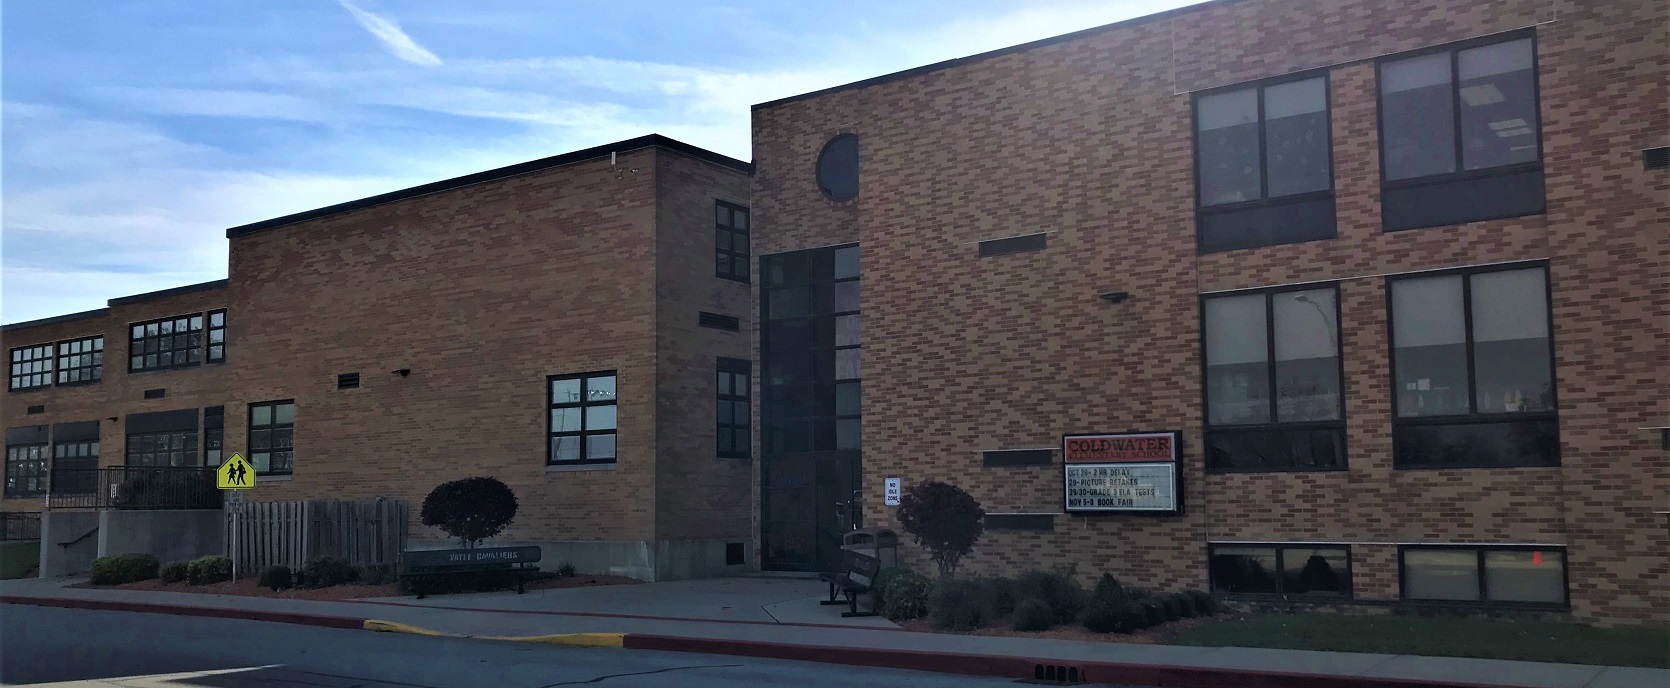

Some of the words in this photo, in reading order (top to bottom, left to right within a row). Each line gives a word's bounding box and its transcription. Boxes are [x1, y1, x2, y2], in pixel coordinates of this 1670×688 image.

[1068, 438, 1170, 452] COLDWATER
[1069, 451, 1126, 460] ELEMENTARY
[1132, 450, 1169, 458] SCHOOL
[1110, 468, 1130, 476] DELAY
[1109, 478, 1138, 486] RETAKES
[1135, 488, 1155, 496] TESTS
[1069, 498, 1081, 506] NOV
[1097, 498, 1114, 506] BOOK
[1117, 498, 1133, 506] FAIR
